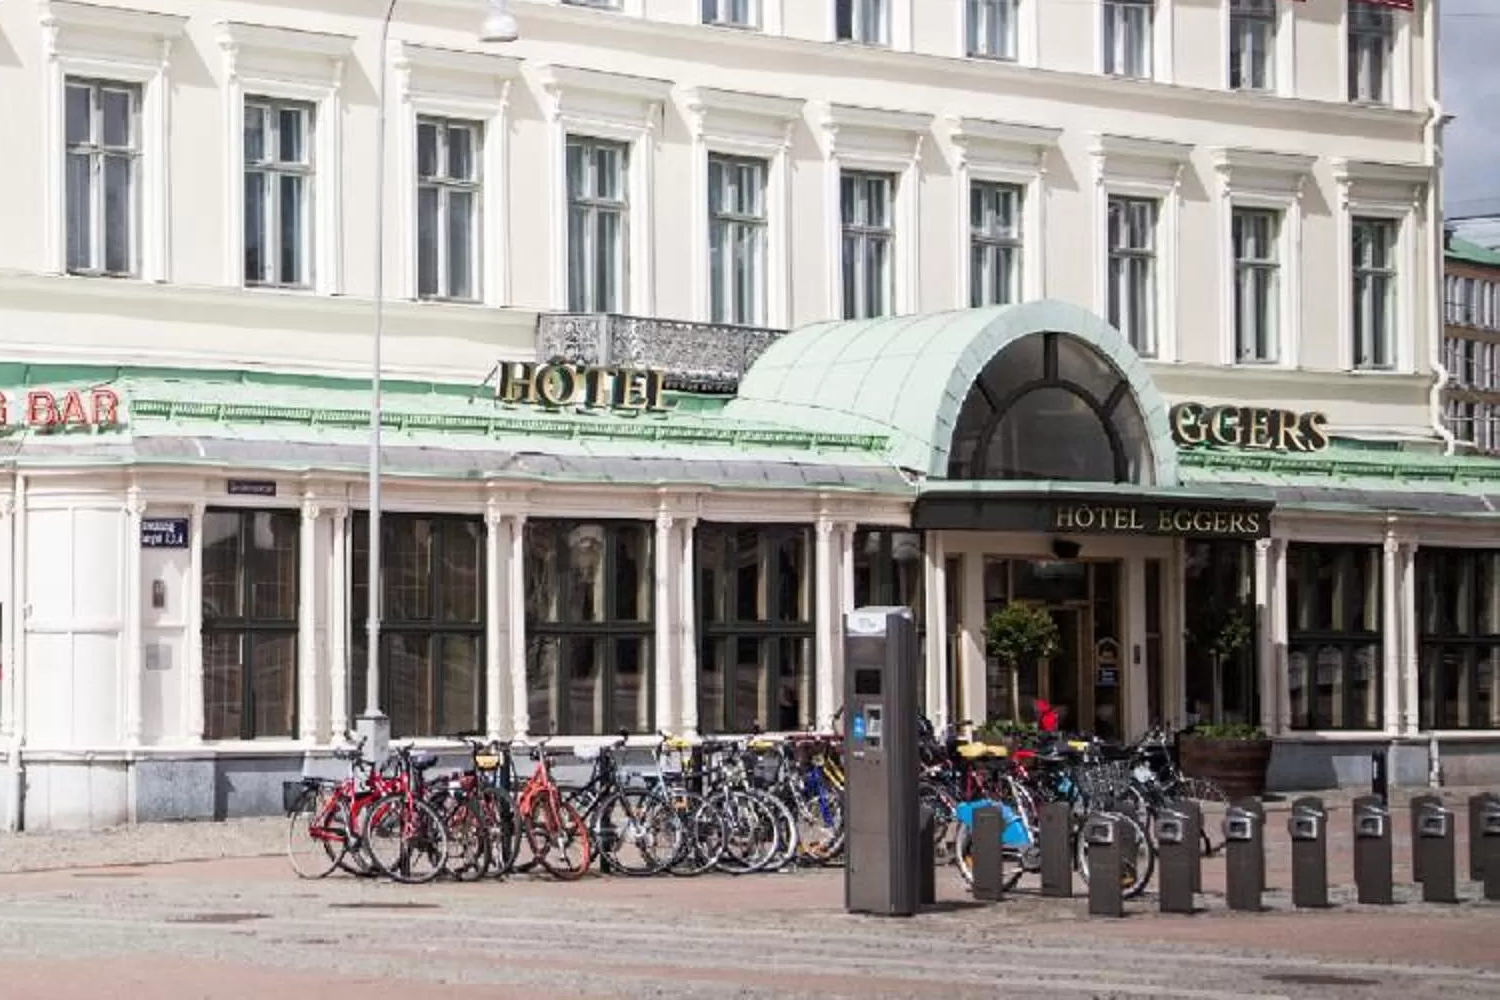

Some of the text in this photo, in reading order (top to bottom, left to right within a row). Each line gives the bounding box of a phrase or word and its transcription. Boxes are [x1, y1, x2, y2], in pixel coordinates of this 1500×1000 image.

[24, 387, 120, 426] BAR
[1170, 401, 1329, 452] GGERS
[1158, 508, 1260, 533] EGGERS
